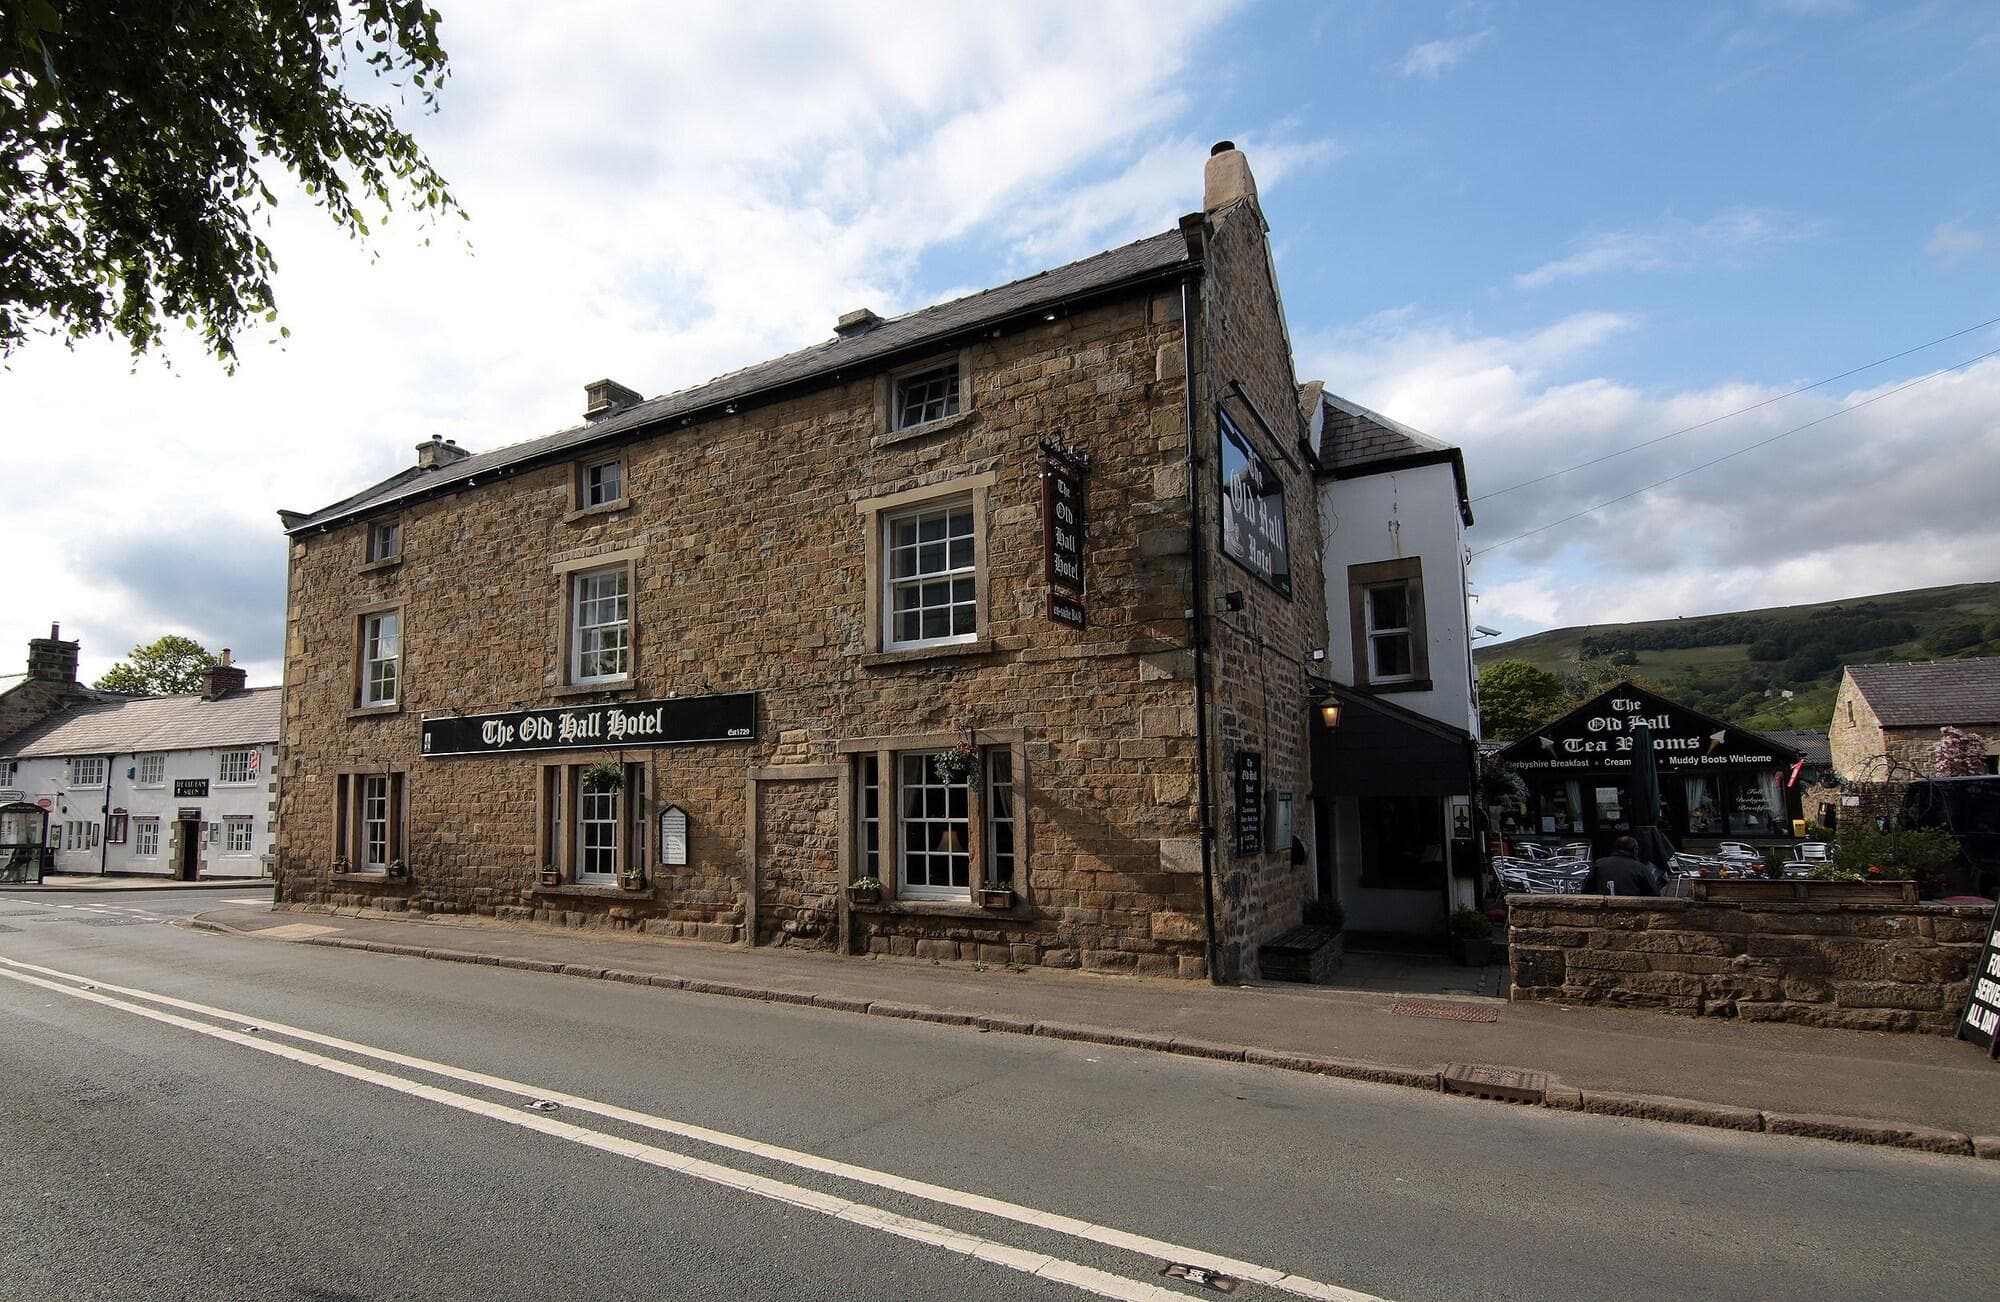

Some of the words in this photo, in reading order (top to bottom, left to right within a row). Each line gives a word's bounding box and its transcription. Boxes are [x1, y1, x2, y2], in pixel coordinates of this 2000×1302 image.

[1247, 451, 1263, 491] The
[1057, 479, 1070, 498] The
[1056, 501, 1073, 525] Old
[1230, 468, 1256, 526] Old
[1257, 494, 1283, 553] Hall
[1055, 526, 1075, 553] Hall
[1054, 552, 1078, 581] Hotel
[1248, 533, 1271, 576] Hotel
[1610, 698, 1641, 712] The
[482, 719, 515, 748] The
[519, 716, 553, 742] Old
[558, 712, 602, 743] Hall
[606, 707, 664, 741] Hotel
[1587, 716, 1622, 732] Old
[1627, 714, 1671, 733] Hall
[1562, 737, 1608, 753] Tea
[1615, 736, 1701, 752] Roms
[1550, 759, 1589, 767] Breakfast
[1604, 758, 1632, 766] Cream
[1669, 756, 1699, 765] Muddy
[1701, 755, 1728, 764] Boots
[1729, 754, 1772, 763] Welcome
[1966, 1003, 1983, 1028] ALL
[1980, 1009, 2000, 1036] DAY
